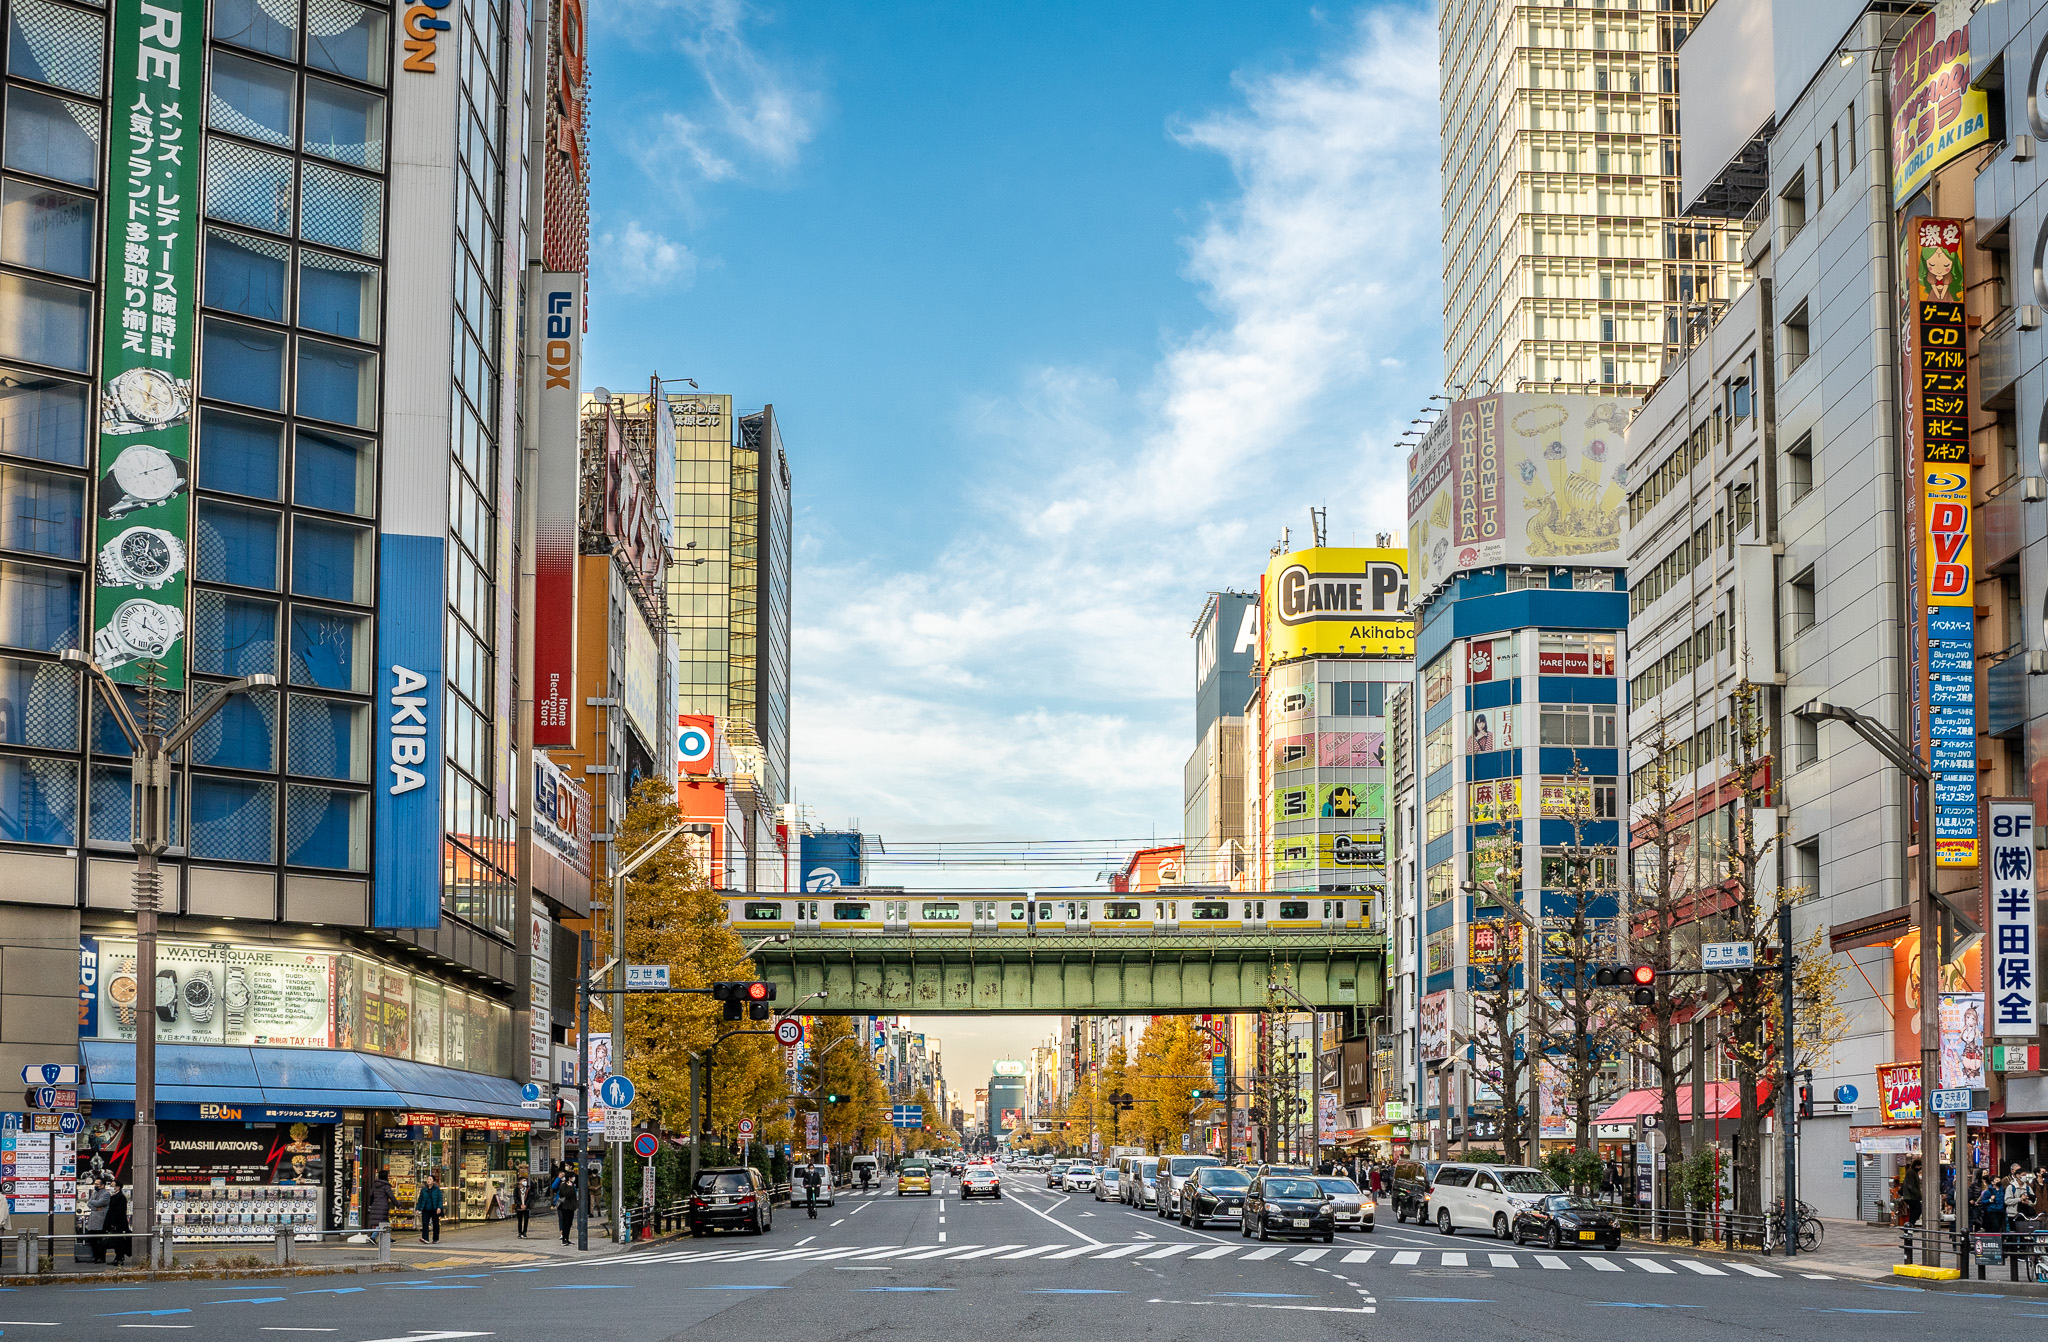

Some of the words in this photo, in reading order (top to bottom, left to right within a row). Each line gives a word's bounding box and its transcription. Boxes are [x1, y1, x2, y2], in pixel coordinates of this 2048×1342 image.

[1937, 113, 1985, 153] AKIBA
[122, 93, 154, 354] 人気ブランド多数取り揃え
[151, 102, 183, 360] メンズ・レディース腕時計
[1923, 304, 1962, 323] ゲーム
[1928, 328, 1959, 345] CD
[1924, 350, 1964, 368] アイドル
[1924, 373, 1966, 391] アニメ
[1925, 397, 1964, 414] コミック
[1928, 419, 1963, 437] ホビー
[1478, 399, 1498, 501] WELCOME
[1926, 442, 1965, 460] フィギュア
[1409, 453, 1451, 514] TAKARADA
[1459, 411, 1477, 542] AKIHABARA
[1927, 492, 1952, 500] Blu-ray
[1482, 507, 1497, 537] TO
[1929, 501, 1970, 597] DVD
[1282, 570, 1363, 616] GAME
[1928, 606, 1939, 614] 6F
[1931, 620, 1971, 630] イベントスペース
[1928, 640, 1940, 648] 5F
[1928, 673, 1940, 681] 4F
[550, 673, 560, 726] Electronics
[540, 700, 550, 726] Store
[558, 698, 568, 726] Home
[1929, 706, 1941, 714] 3F
[389, 664, 427, 795] AKIBA
[1993, 815, 2032, 838] 8F
[167, 947, 217, 959] WATCH
[219, 950, 273, 962] SQUARE
[1707, 946, 1748, 958] 万世橋
[1705, 958, 1734, 966] Manseibashi
[1735, 957, 1750, 966] Bridge
[630, 970, 666, 979] 万世橋
[782, 1026, 796, 1038] 50
[290, 1036, 305, 1046] TAX
[44, 1090, 54, 1103] 17
[1944, 1092, 1966, 1101] 中央通り
[36, 1116, 58, 1125] 中央通り
[304, 1110, 337, 1118] エディオン
[62, 1118, 75, 1129] 437
[170, 1141, 215, 1150] TAMASHII
